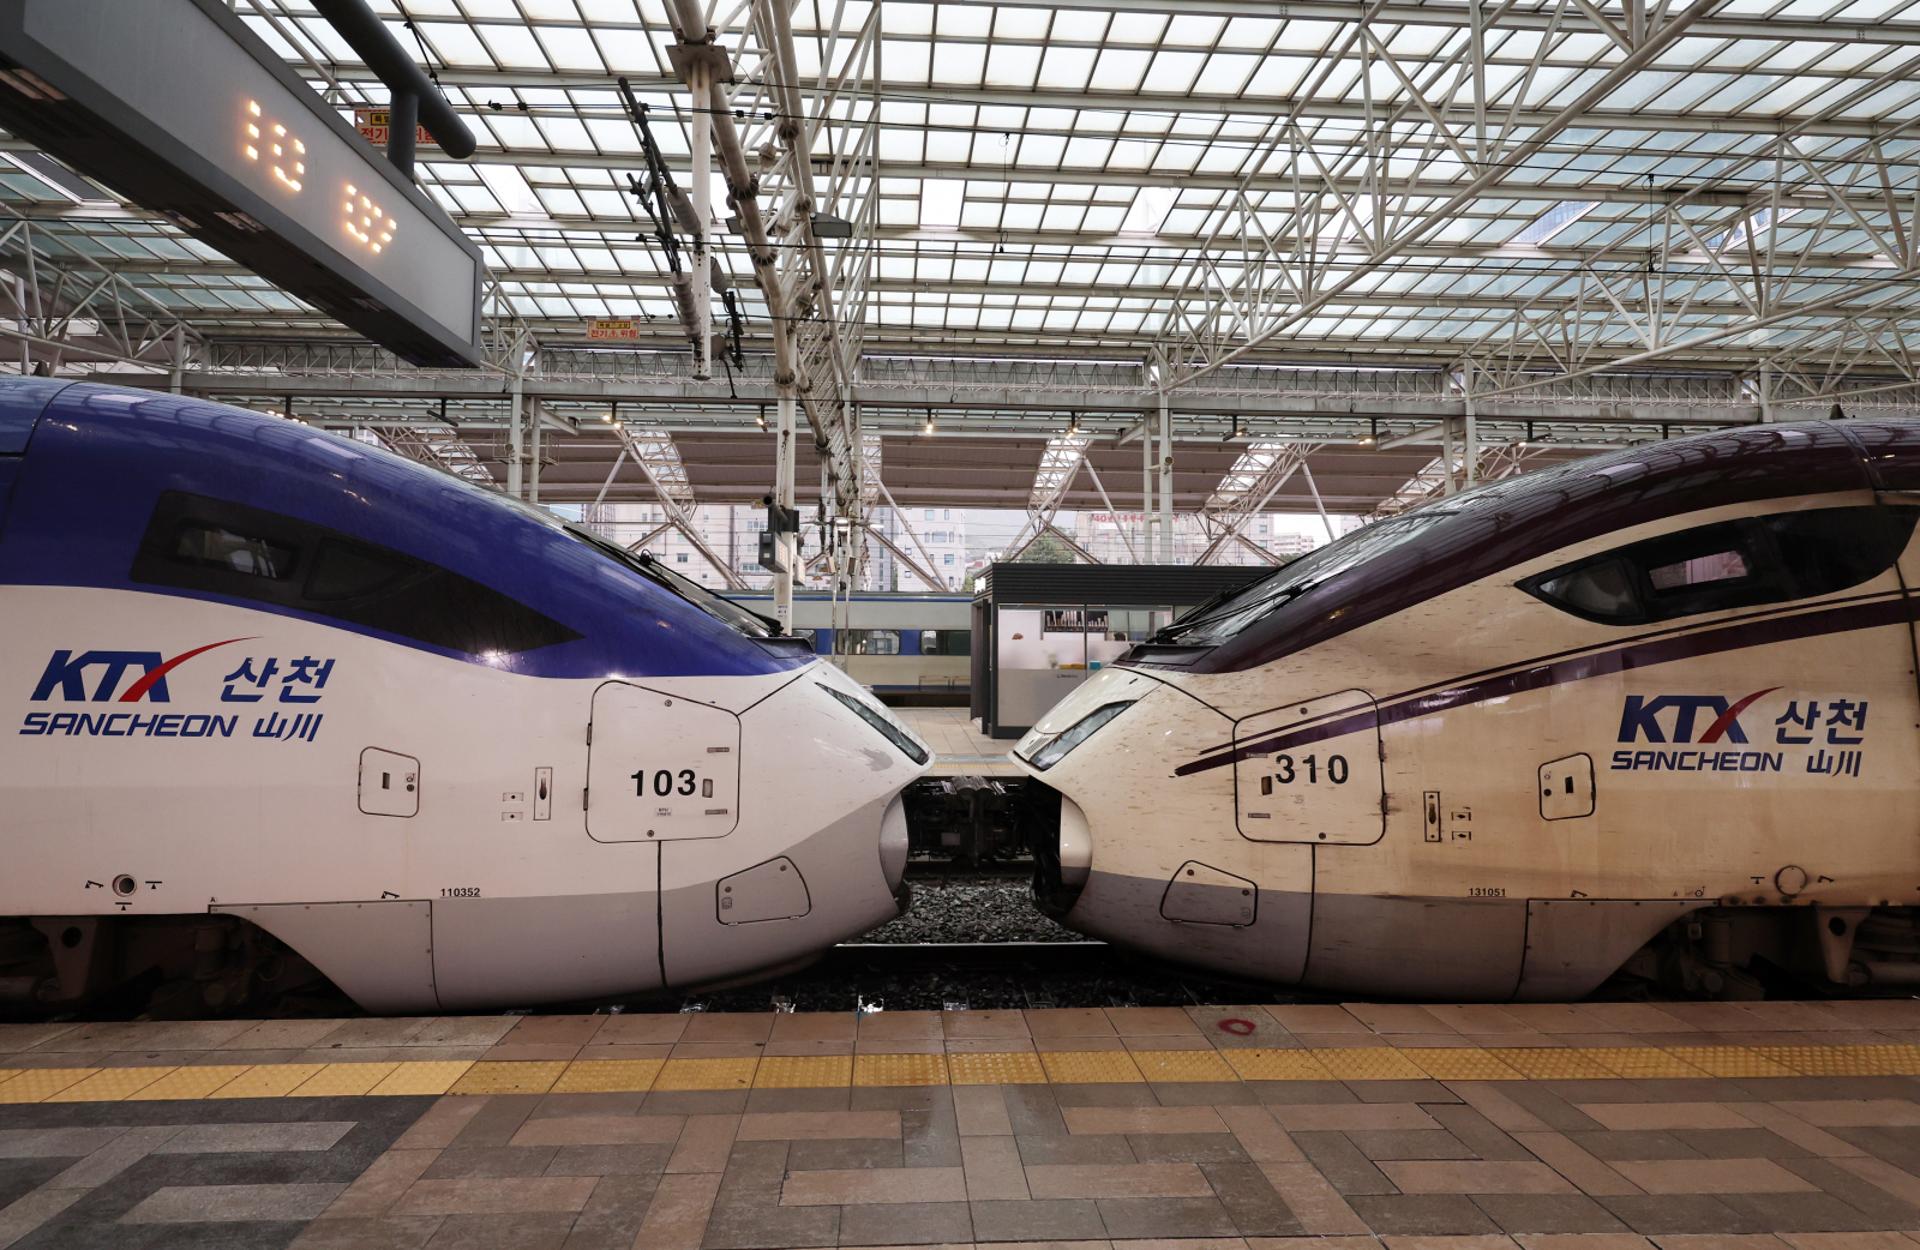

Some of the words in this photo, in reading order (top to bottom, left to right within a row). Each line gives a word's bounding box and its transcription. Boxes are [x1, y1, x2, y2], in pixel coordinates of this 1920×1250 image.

[30, 636, 264, 703] KTX
[220, 655, 336, 704] 산천
[19, 711, 239, 738] SANCHEON
[252, 711, 324, 743] 山川
[1617, 686, 1785, 744] KTX
[1775, 699, 1869, 745] 산천
[1275, 753, 1349, 784] 310
[1610, 750, 1784, 772] SANCHEON
[1806, 749, 1863, 778] 山川
[630, 769, 697, 797] 103
[440, 887, 481, 898] 110352
[1468, 887, 1506, 897] 131051
